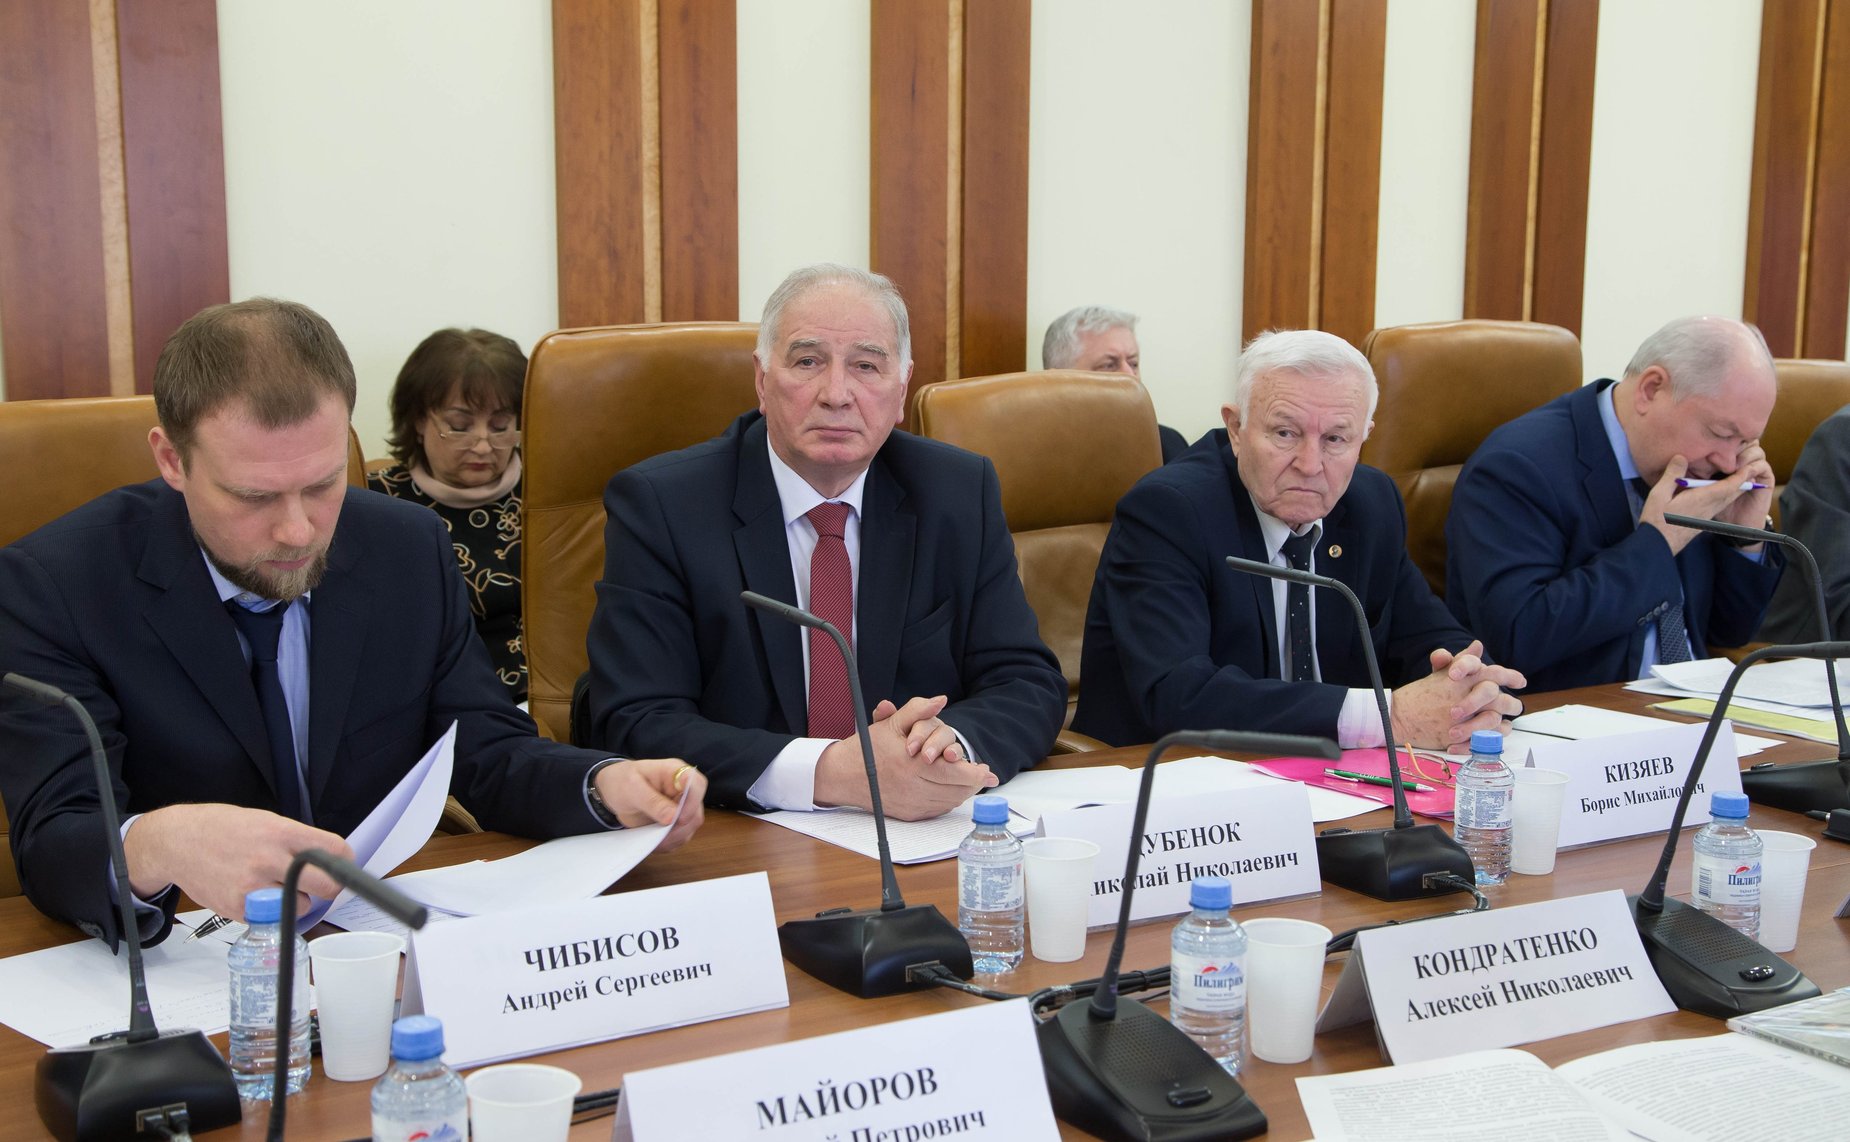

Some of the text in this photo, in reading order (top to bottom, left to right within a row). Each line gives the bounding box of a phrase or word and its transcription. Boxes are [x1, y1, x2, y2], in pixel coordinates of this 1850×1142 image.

[1604, 757, 1675, 784] КИЗЯЕВ
[1581, 782, 1705, 815] Борис Михайлоч
[1137, 822, 1242, 859] УБЕНОК
[1091, 852, 1299, 896] иклай Николаевич
[1728, 874, 1762, 888] Пилигр
[524, 926, 681, 973] ЧИБИСОВ
[1413, 927, 1599, 980] КОНДРАТЕНКО
[502, 962, 713, 1015] Андрей Сергеевич
[1407, 965, 1635, 1023] Алексей Николаевич
[755, 1067, 938, 1130] МАЙОРОВ
[850, 1110, 987, 1142] Петрович
